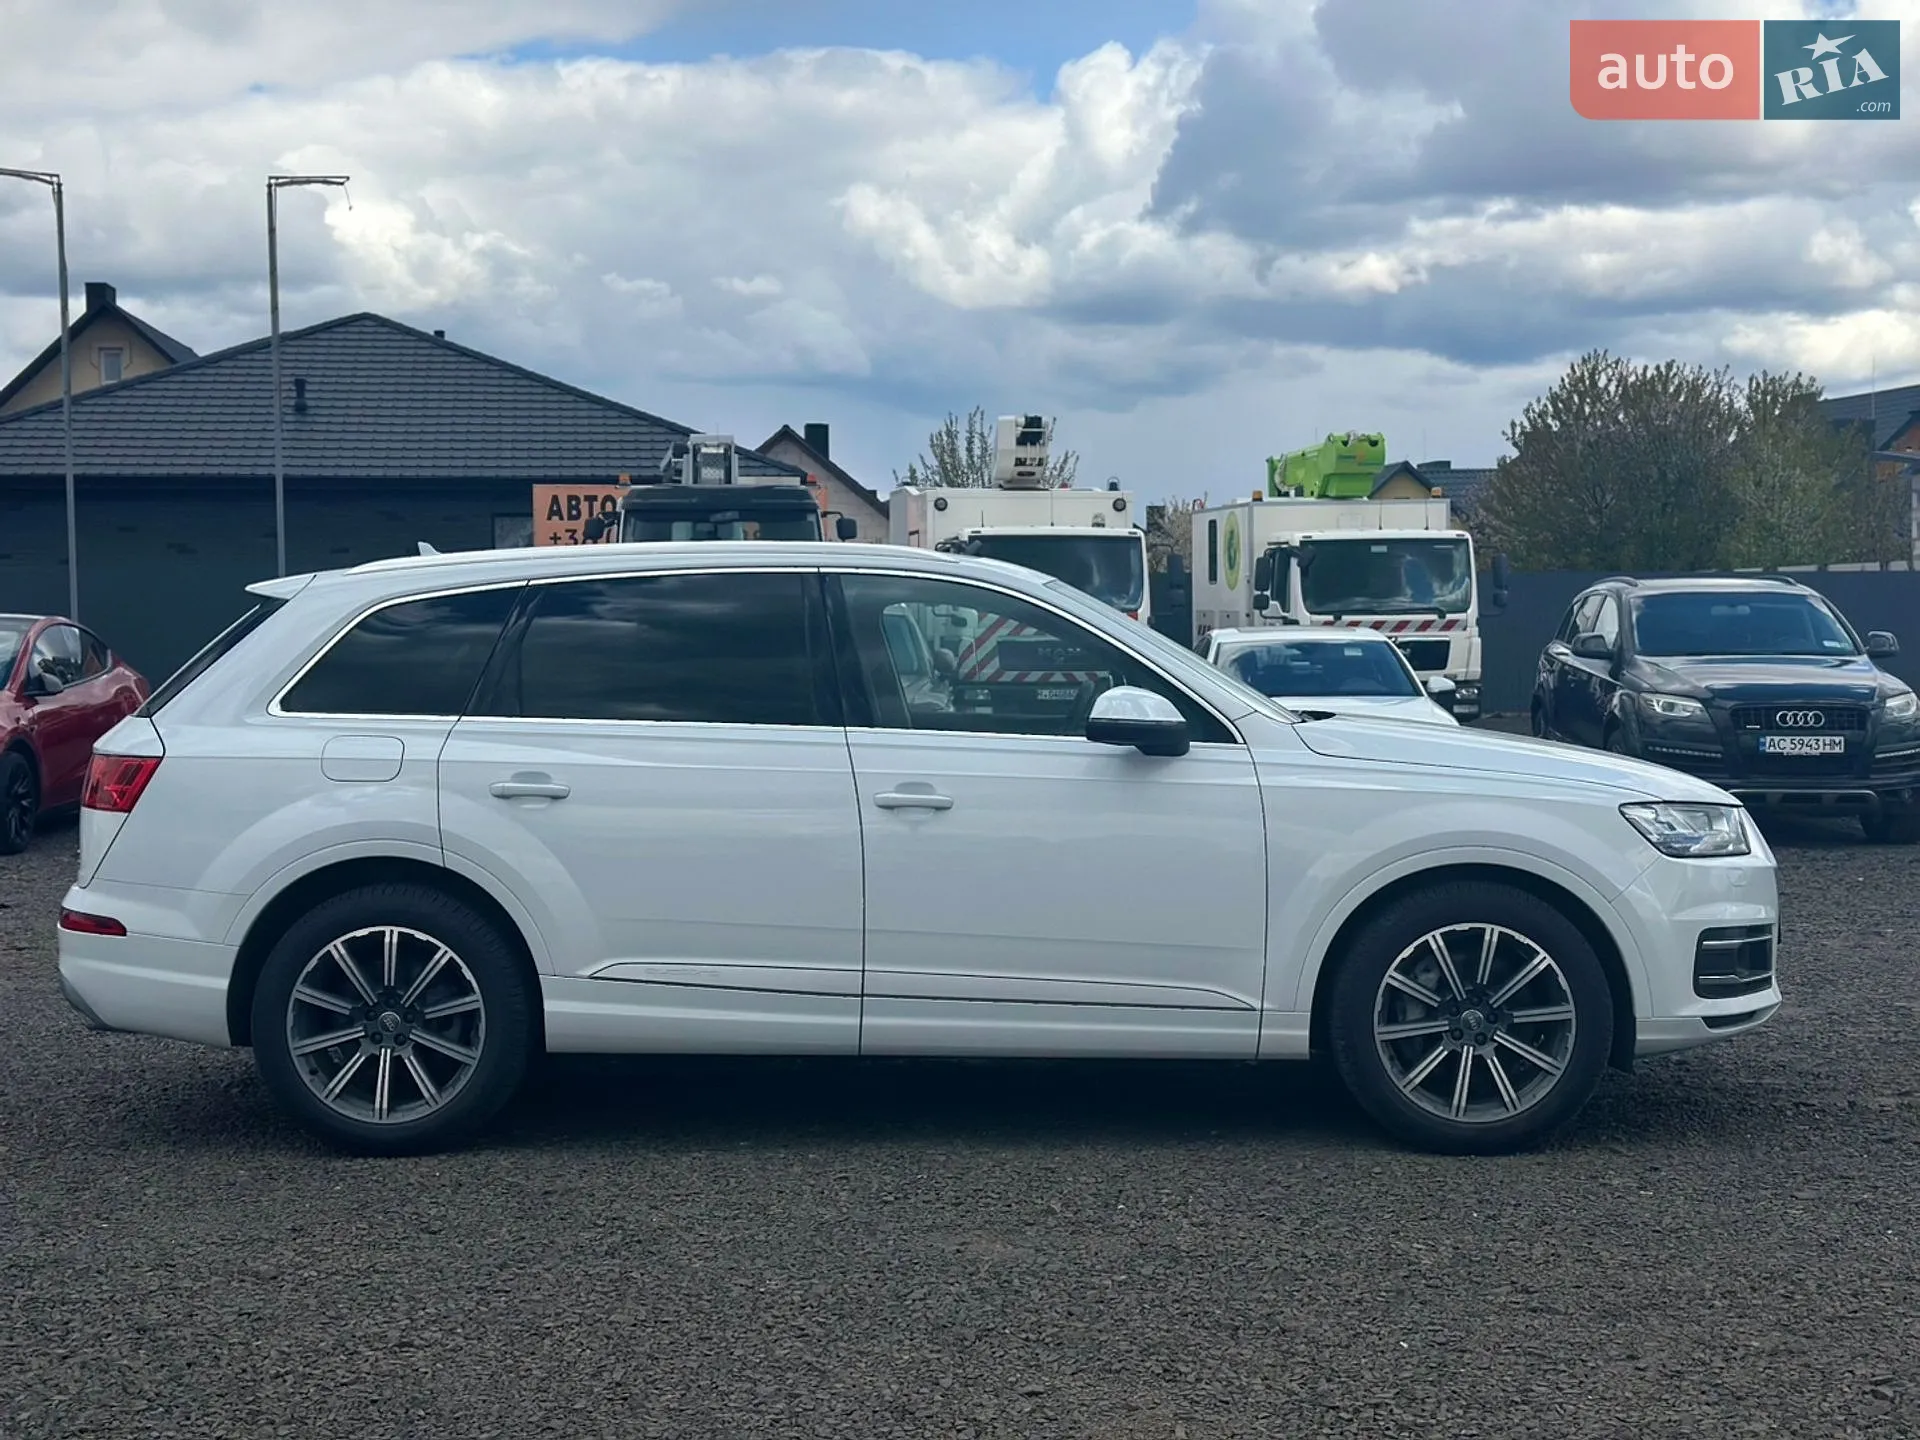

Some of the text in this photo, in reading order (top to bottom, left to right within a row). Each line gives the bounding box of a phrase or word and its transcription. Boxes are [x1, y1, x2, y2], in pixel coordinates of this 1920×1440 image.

[1768, 738, 1842, 750] AC 5943 HM
